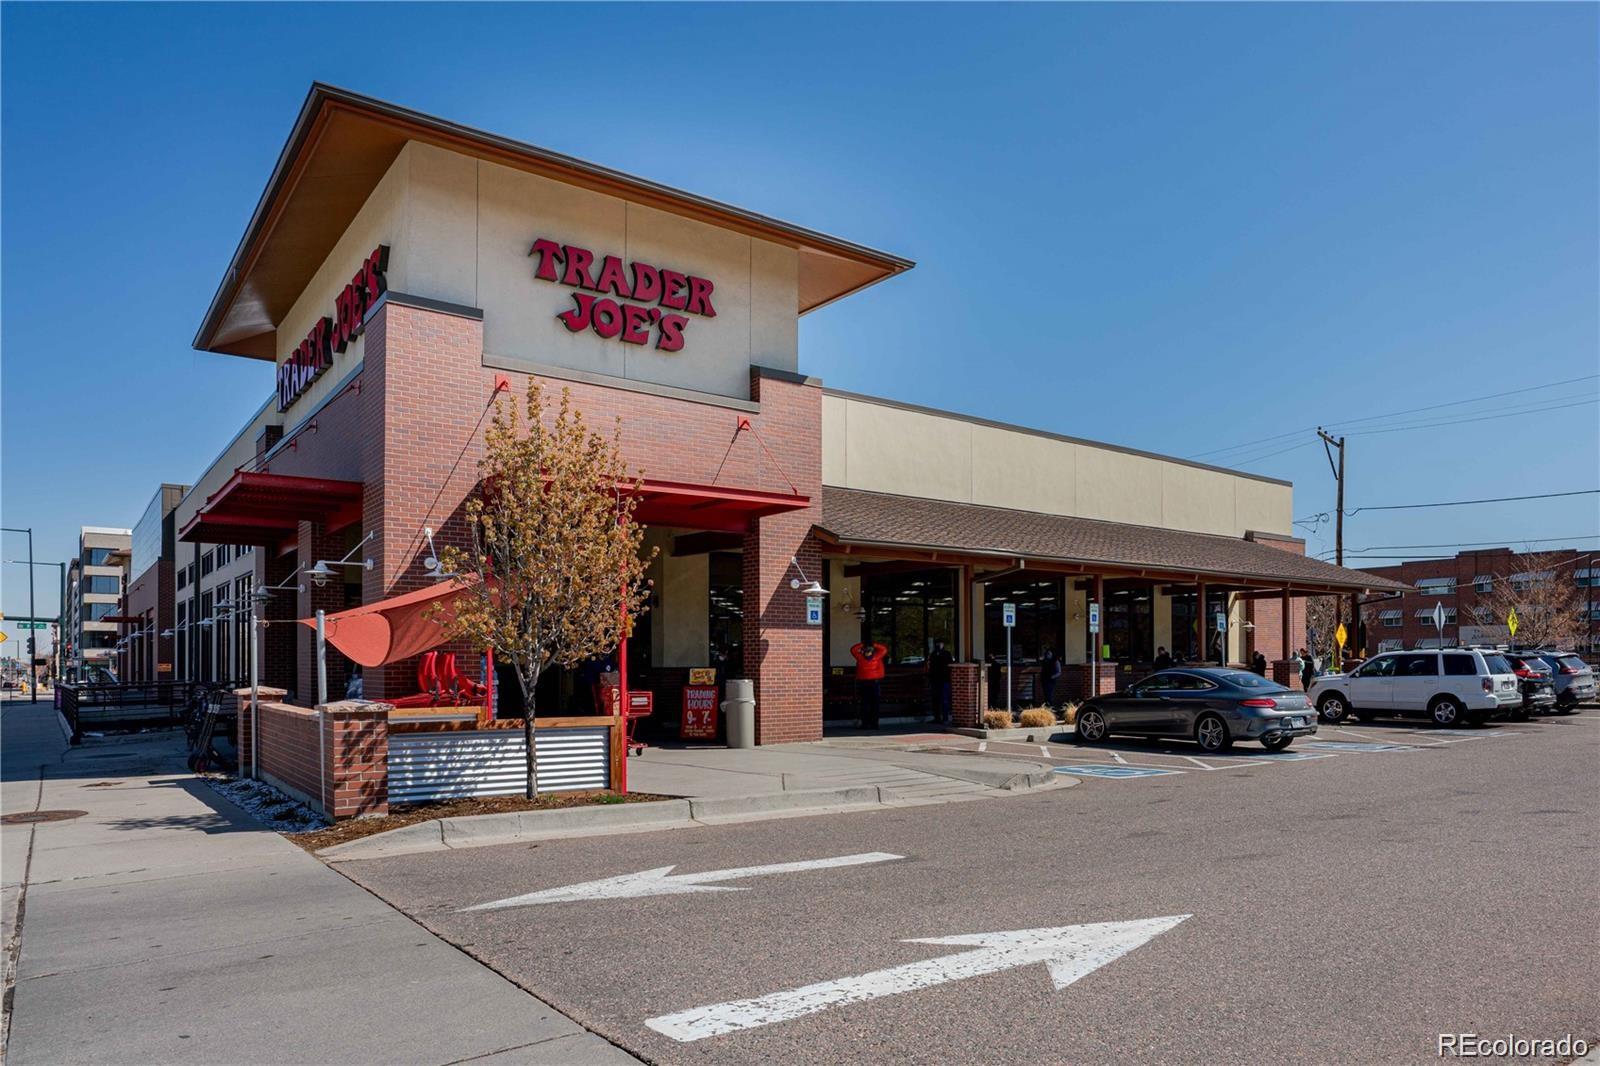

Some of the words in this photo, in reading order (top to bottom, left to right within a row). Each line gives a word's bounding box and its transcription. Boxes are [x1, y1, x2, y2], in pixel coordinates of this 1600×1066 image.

[528, 238, 717, 317] TRADER
[556, 292, 690, 352] JOE'S
[277, 316, 333, 413] TRADER
[687, 699, 714, 710] HOURS
